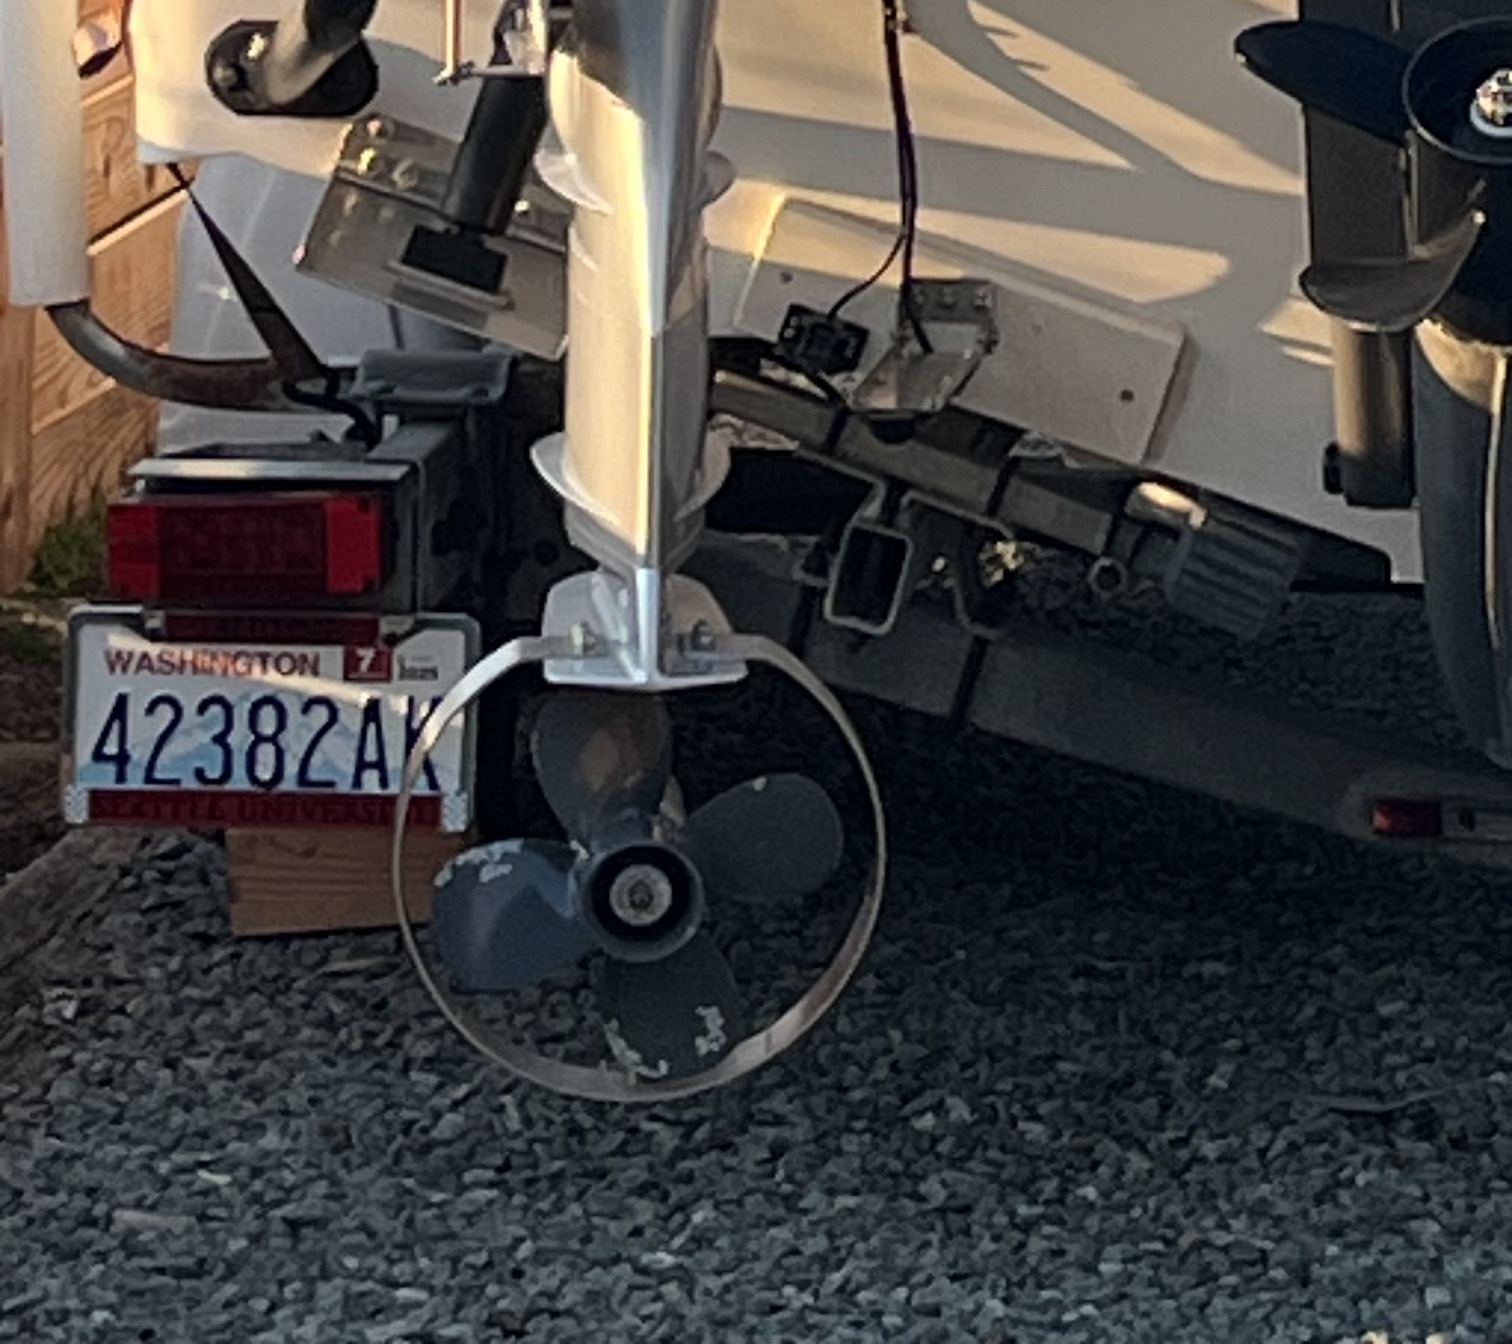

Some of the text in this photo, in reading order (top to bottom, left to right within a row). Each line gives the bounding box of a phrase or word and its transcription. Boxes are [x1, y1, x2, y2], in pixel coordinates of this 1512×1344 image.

[104, 648, 321, 677] WASHINGTON
[354, 646, 378, 674] 7
[91, 692, 445, 792] 42382AK
